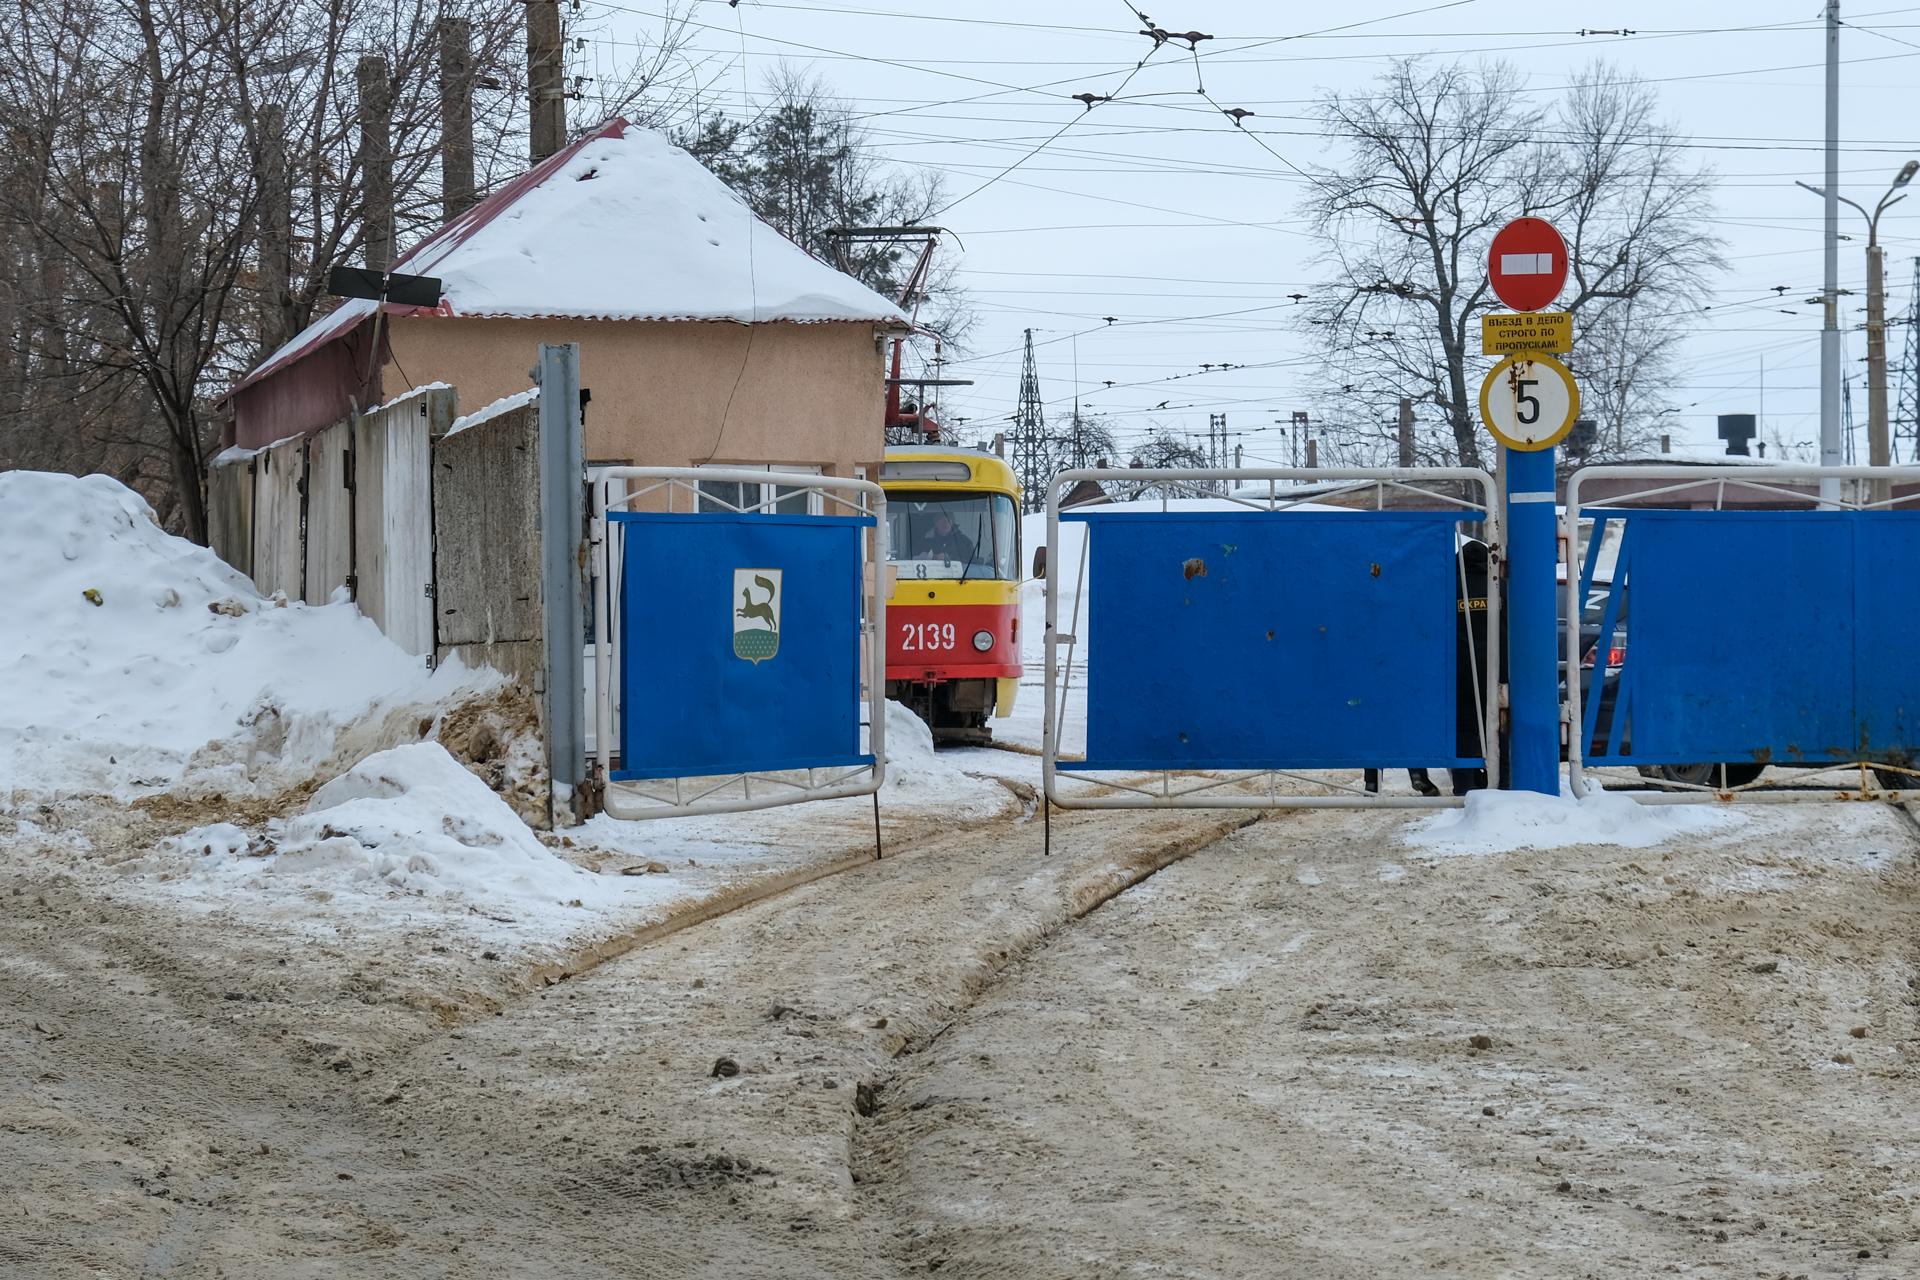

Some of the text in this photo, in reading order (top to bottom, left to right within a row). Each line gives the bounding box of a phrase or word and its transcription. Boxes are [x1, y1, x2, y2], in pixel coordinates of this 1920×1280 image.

[1488, 316, 1564, 328] ВЪЕЗД В ДЕПО
[1499, 328, 1555, 338] СТРОГО ПО
[1495, 340, 1559, 351] ПРОПУСКАМ!
[1516, 380, 1540, 424] 5
[916, 563, 927, 579] 8
[902, 623, 956, 651] 2139
